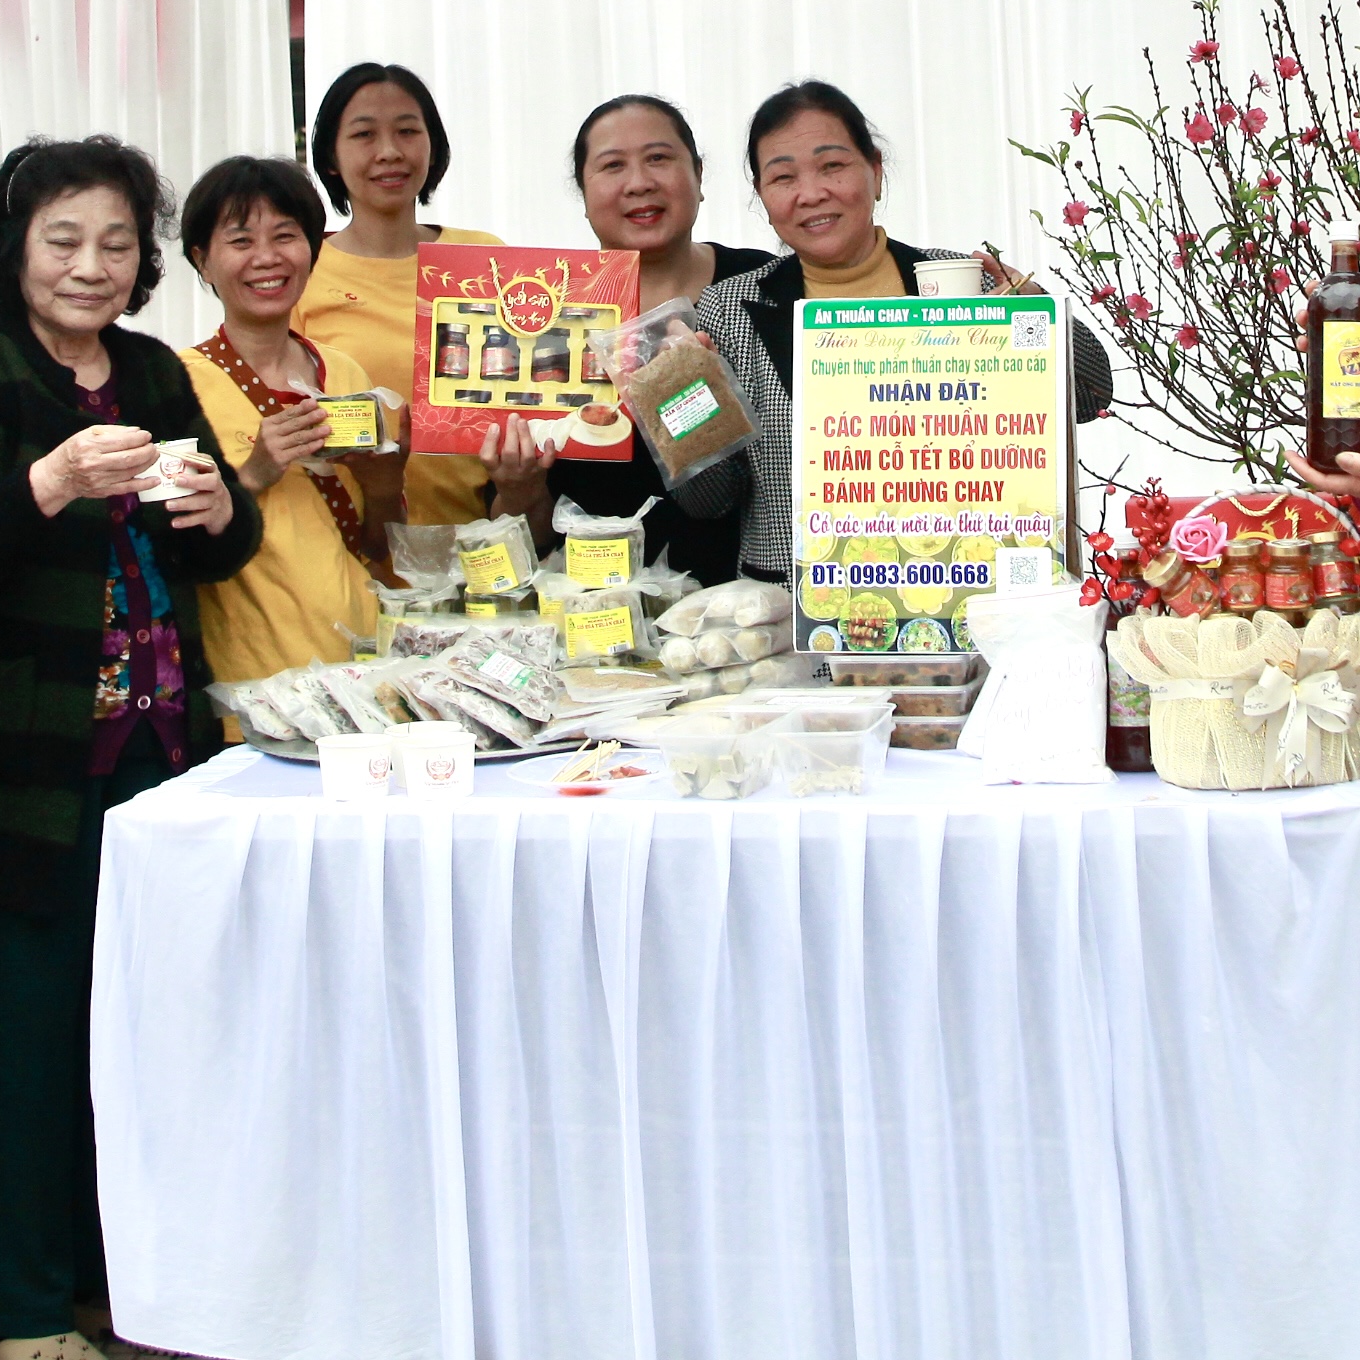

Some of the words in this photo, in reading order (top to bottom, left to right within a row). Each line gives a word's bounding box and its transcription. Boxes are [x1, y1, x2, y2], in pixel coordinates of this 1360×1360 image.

[814, 308, 832, 324] ĂN
[878, 308, 911, 323] CHAY
[921, 308, 945, 325] TẠO
[947, 305, 974, 321] HÒA
[975, 304, 1006, 321] BÌNH
[814, 330, 858, 348] Thiên
[864, 329, 906, 353] Đàng
[911, 328, 961, 346] Thuần
[967, 327, 1008, 352] Chay
[811, 357, 850, 377] Chuyên
[853, 358, 875, 378] thực
[879, 353, 908, 377] phẩm
[945, 357, 971, 376] chay
[974, 356, 999, 377] sạch
[1003, 358, 1023, 372] cao
[1027, 352, 1047, 374] cấp
[869, 379, 931, 406] NHẬN
[938, 378, 987, 406] ĐẶT:
[823, 411, 862, 437] CÁC
[870, 410, 916, 437] MÓN
[923, 407, 988, 436] THUẦN
[995, 413, 1047, 436] CHAY
[823, 446, 871, 471] MÂM
[879, 441, 904, 470] CỖ
[910, 442, 942, 470] TẾT
[949, 440, 975, 470] BỔ
[981, 443, 1046, 469] DƯỠNG
[823, 477, 875, 503] BÁNH
[882, 478, 948, 503] CHƯNG
[955, 480, 1004, 502] CHAY
[809, 513, 828, 534] Có
[835, 517, 861, 533] các
[865, 517, 897, 533] món
[901, 515, 929, 533] mời
[934, 518, 954, 533] ăn
[959, 512, 985, 533] thử
[988, 513, 1010, 538] tại
[1015, 510, 1051, 537] quầy
[812, 564, 843, 585] ĐT:
[850, 564, 989, 585] 0983.600.668
